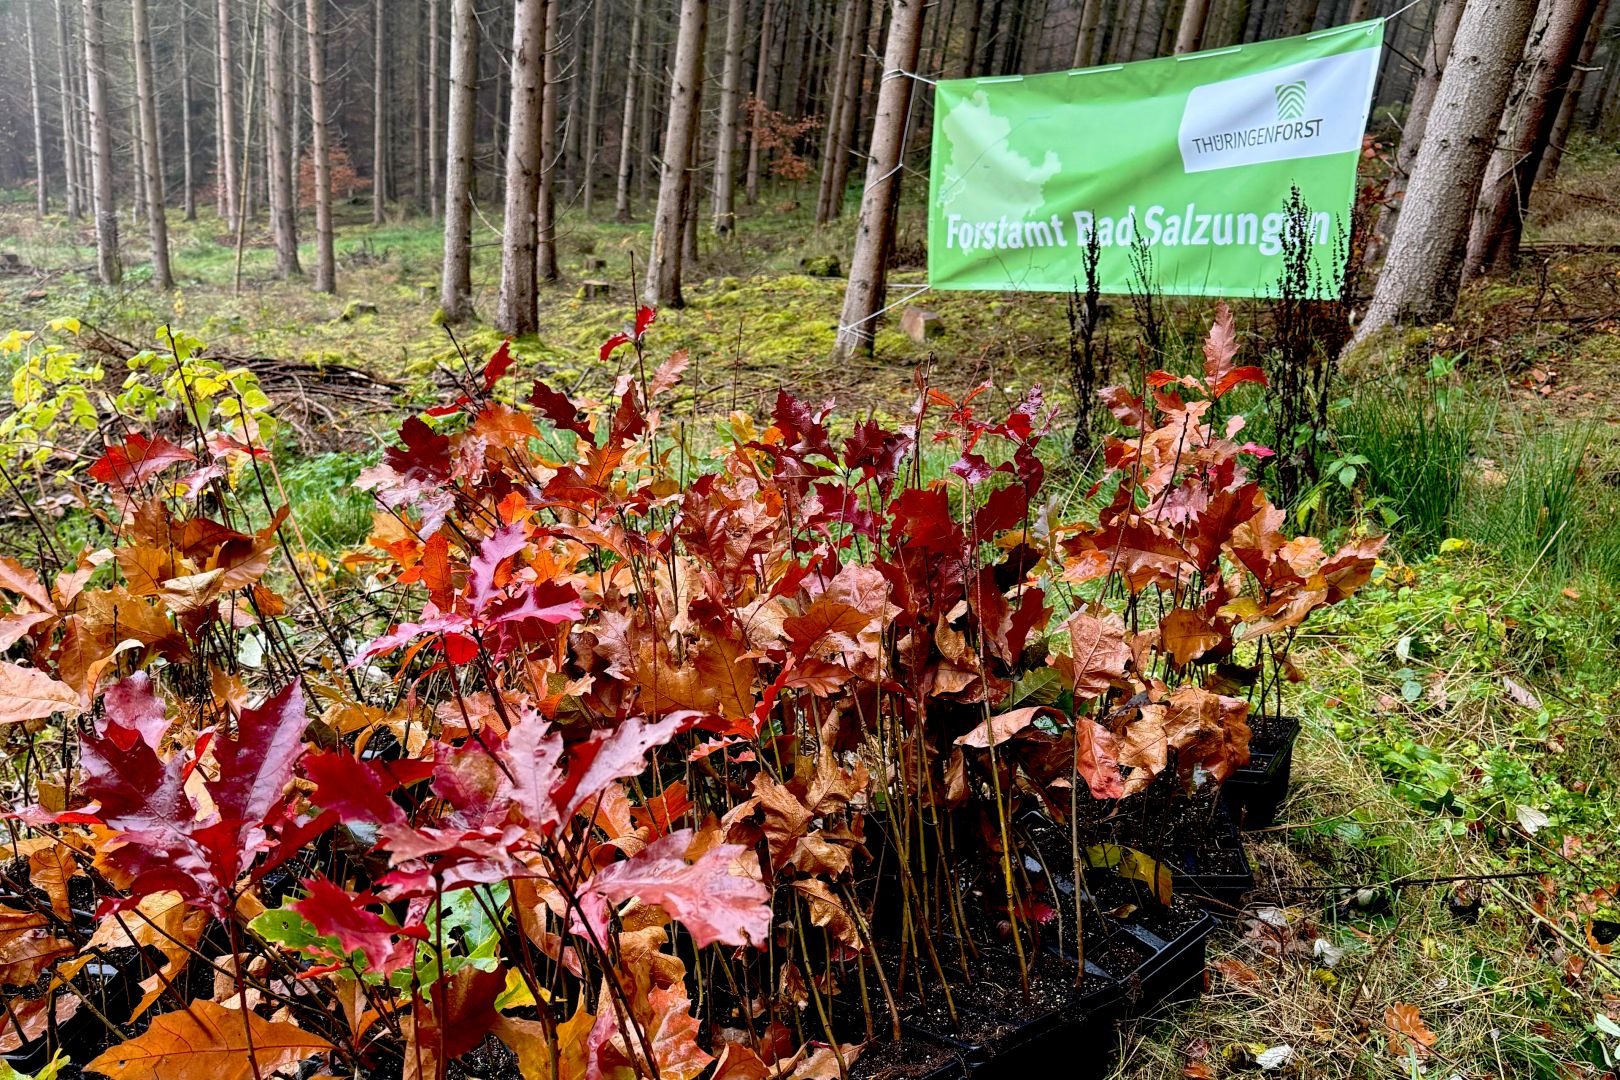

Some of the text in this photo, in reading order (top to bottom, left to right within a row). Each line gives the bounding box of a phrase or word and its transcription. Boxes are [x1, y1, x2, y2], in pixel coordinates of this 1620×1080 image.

[1192, 118, 1323, 154] THÜRINGENFORST
[946, 213, 1068, 250] Forstamt
[1072, 205, 1136, 247] Bad
